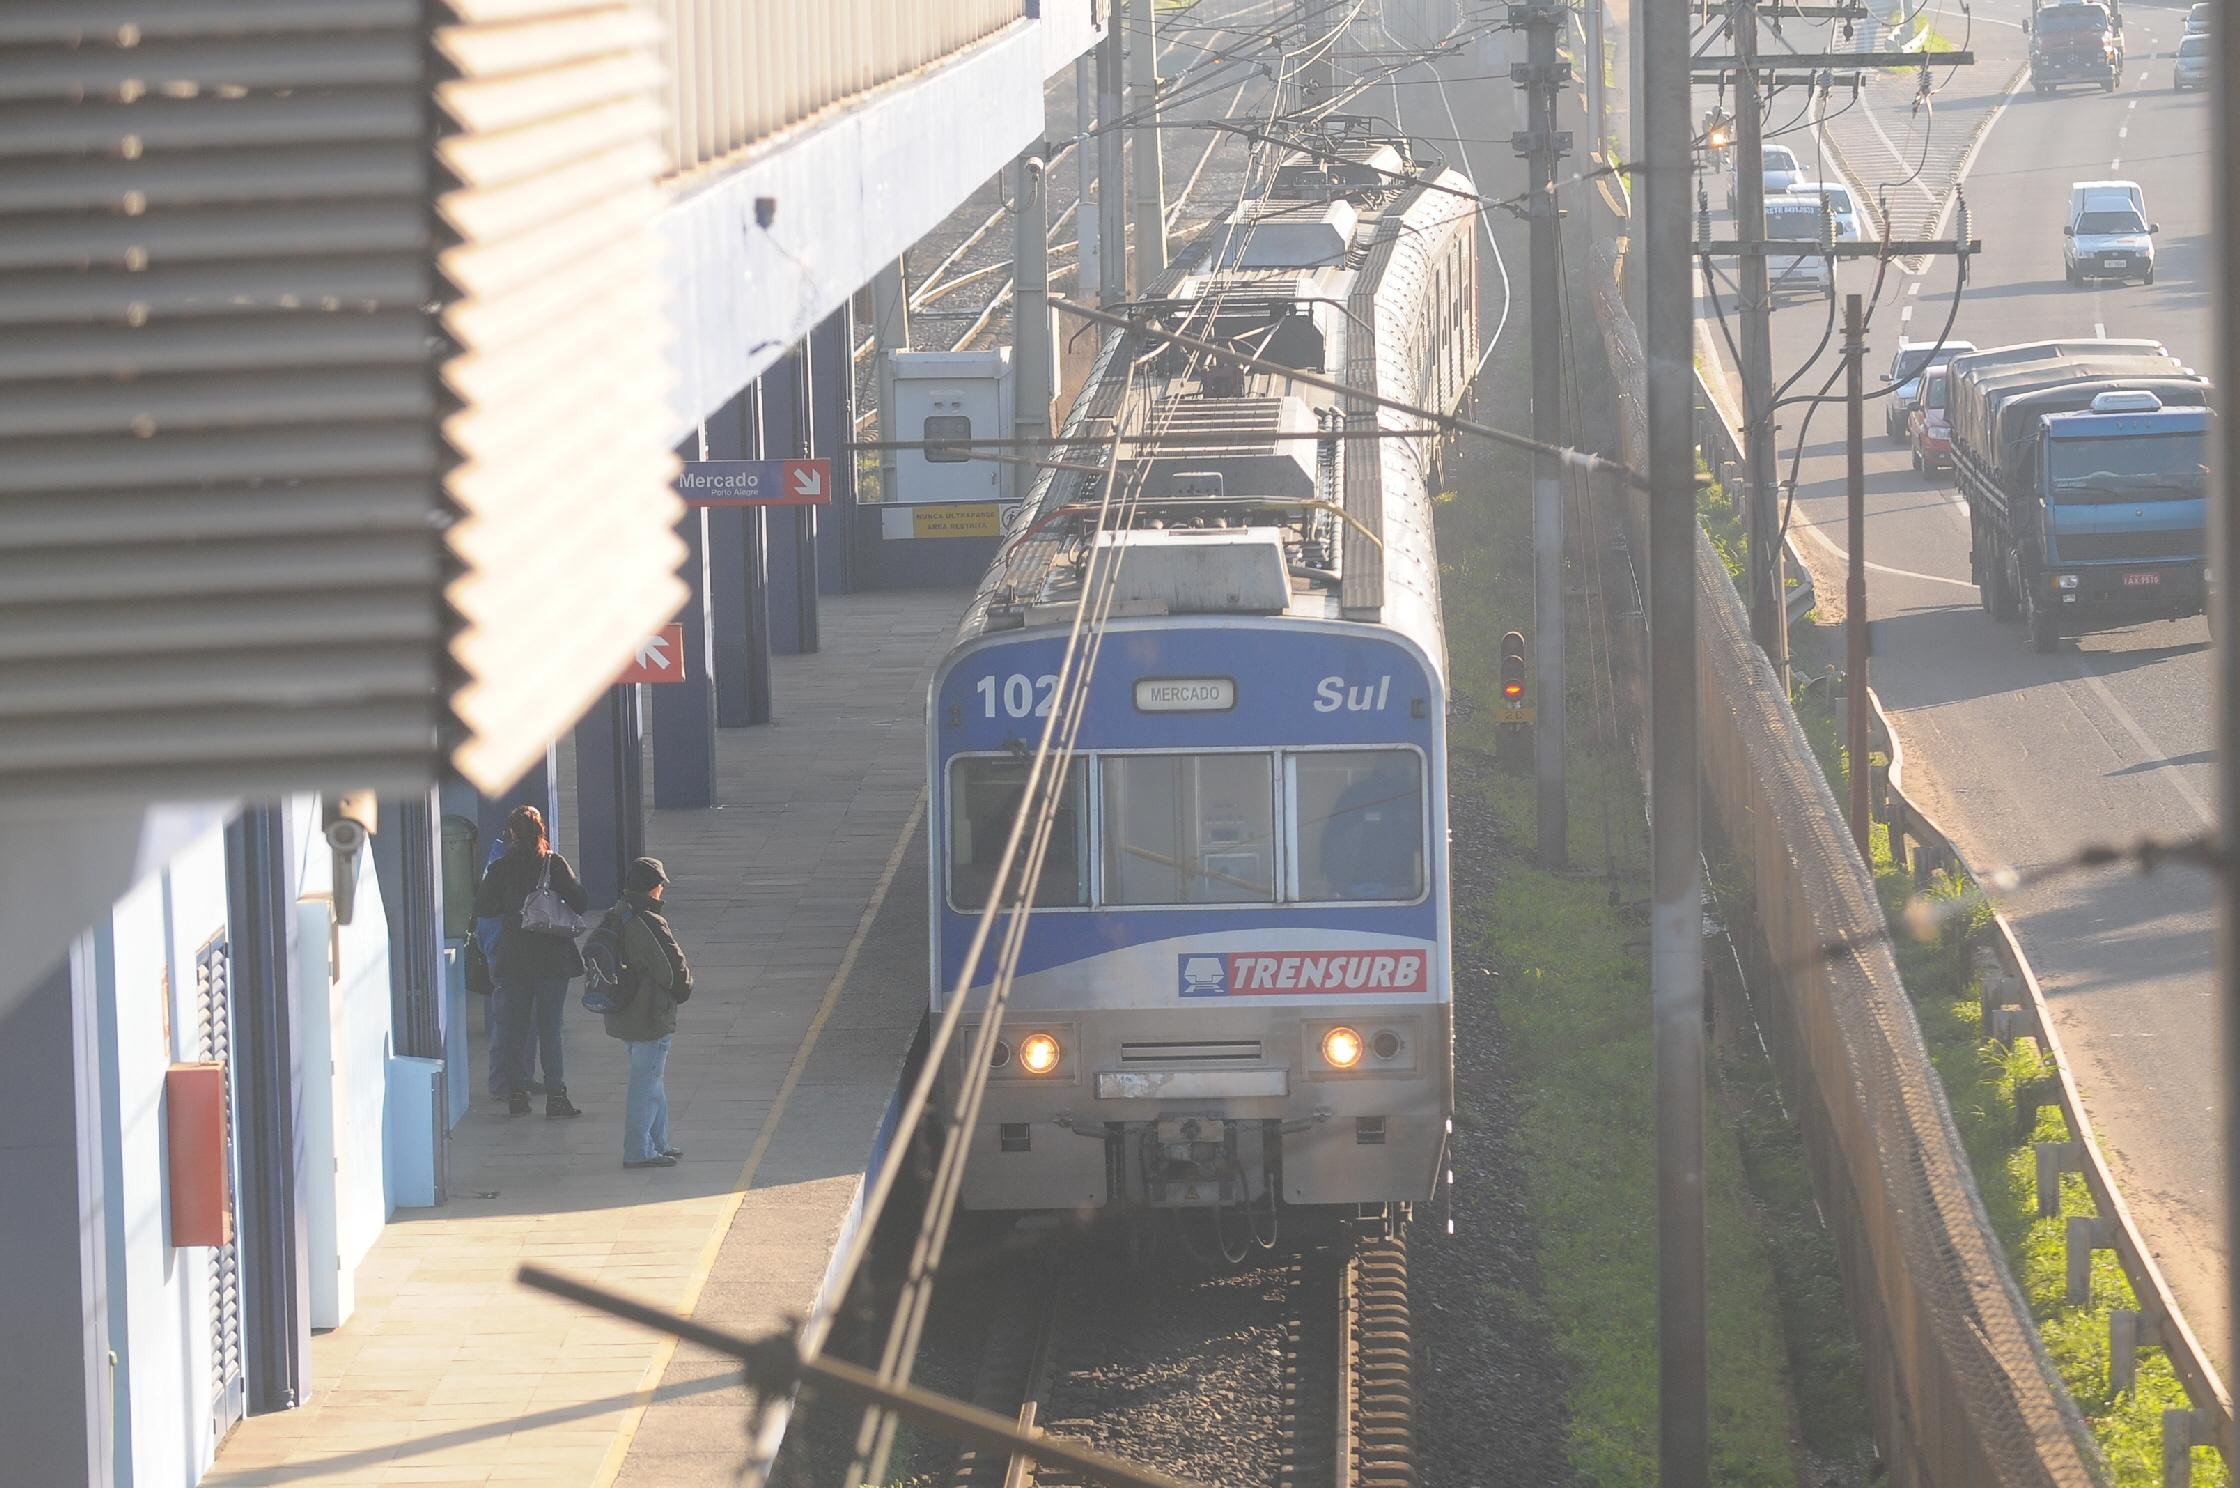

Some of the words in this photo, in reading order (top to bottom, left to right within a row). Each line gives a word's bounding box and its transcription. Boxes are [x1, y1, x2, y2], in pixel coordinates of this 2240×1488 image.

[679, 472, 758, 488] Mercado
[734, 488, 759, 497] Alegre
[976, 673, 1063, 718] 102
[1150, 686, 1220, 702] MERCADO
[1313, 675, 1391, 713] Sul
[1234, 956, 1421, 989] TRENSURB
